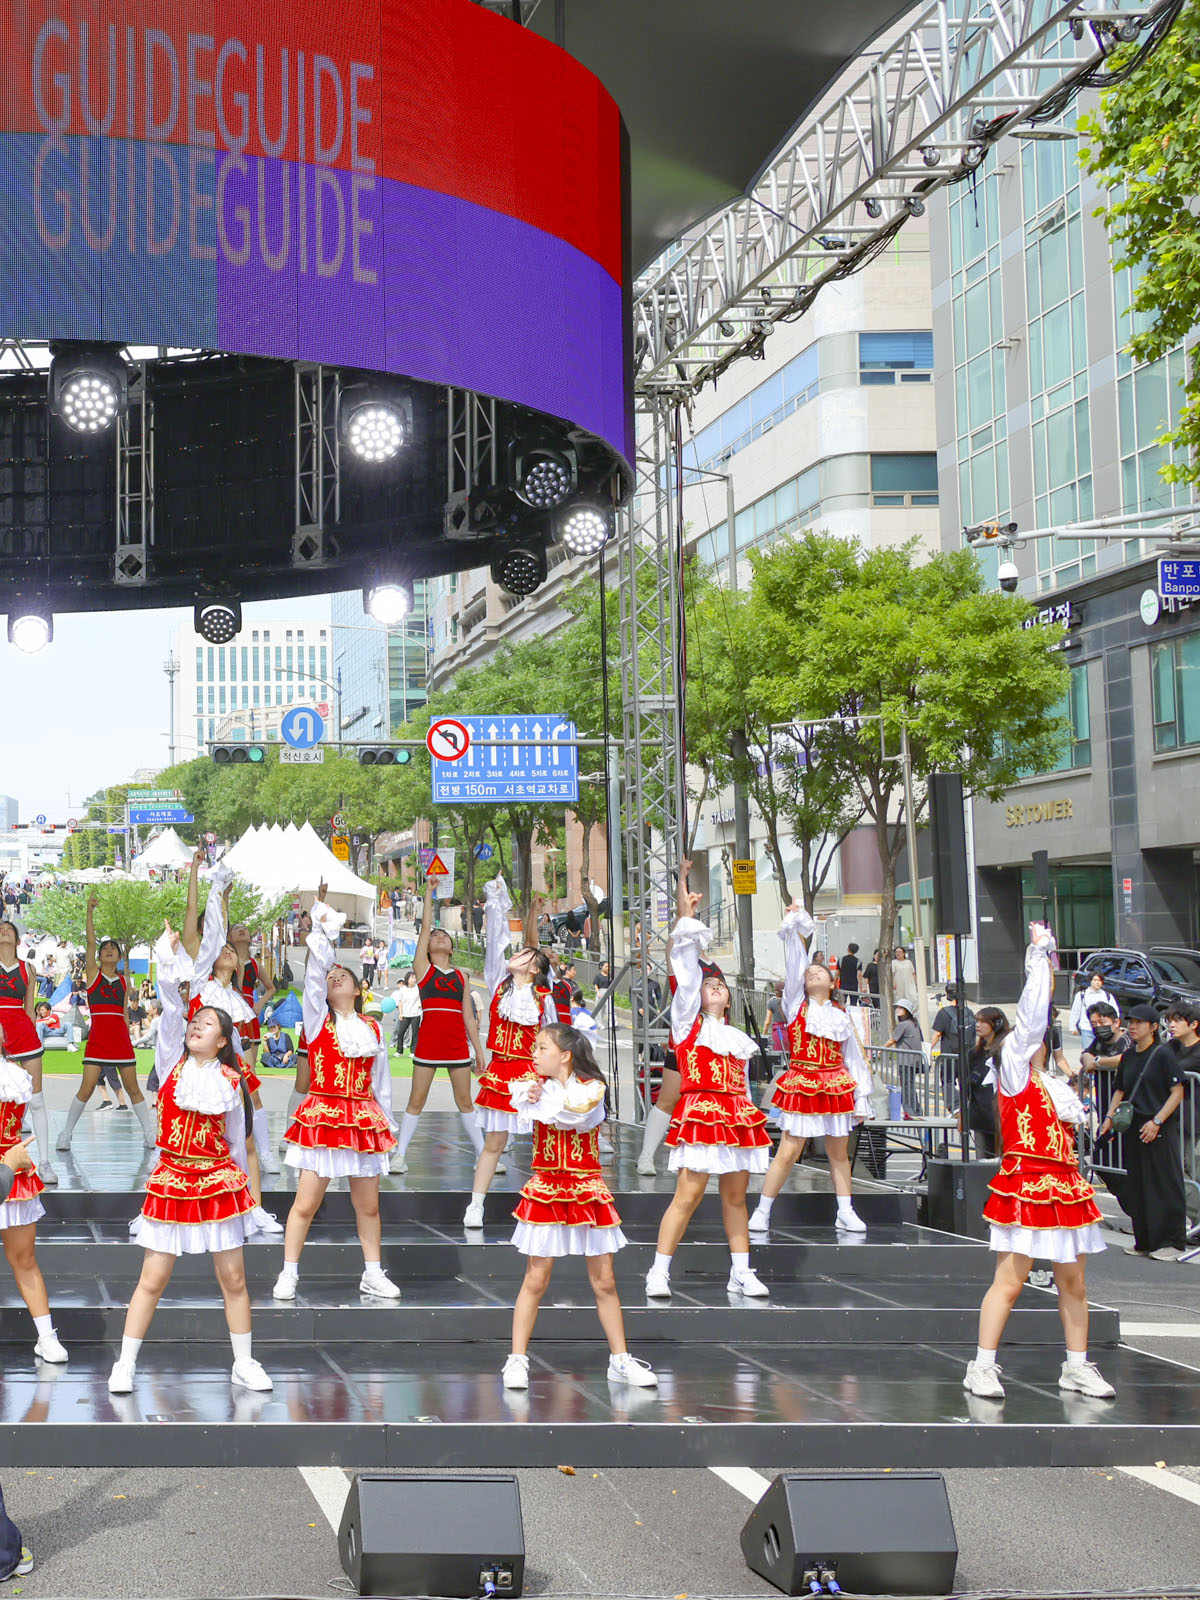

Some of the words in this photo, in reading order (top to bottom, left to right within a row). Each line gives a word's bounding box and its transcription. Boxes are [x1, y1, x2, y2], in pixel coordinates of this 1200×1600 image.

[1164, 563, 1200, 580] 반포
[1164, 582, 1200, 595] Banpo
[282, 752, 322, 762] 적신호시
[441, 770, 458, 778] 1차로
[463, 770, 481, 778] 2차로
[486, 770, 503, 778] 3차로
[531, 769, 548, 777] 5차로
[552, 769, 569, 777] 6차로
[440, 785, 461, 796] 전방
[465, 784, 497, 796] 150m
[504, 784, 569, 795] 서초역교차로
[1025, 798, 1073, 824] TOWER
